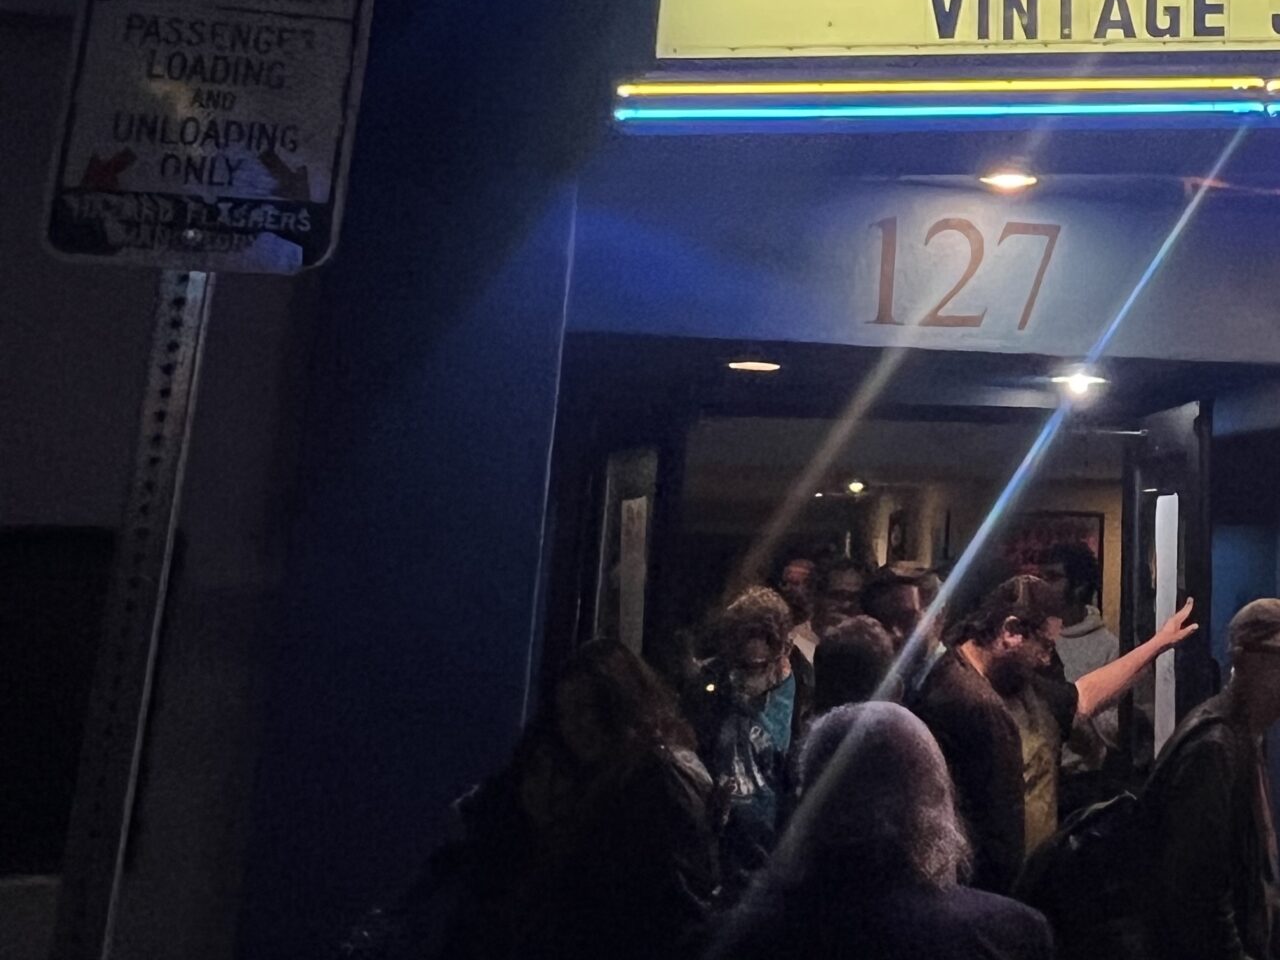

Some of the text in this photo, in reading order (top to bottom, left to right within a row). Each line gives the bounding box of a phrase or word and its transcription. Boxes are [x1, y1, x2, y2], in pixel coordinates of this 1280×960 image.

[146, 51, 286, 90] LOADING
[190, 88, 237, 109] AND
[113, 113, 300, 153] UNLOADING
[160, 153, 244, 187] ONLY
[865, 215, 1062, 331] 127
